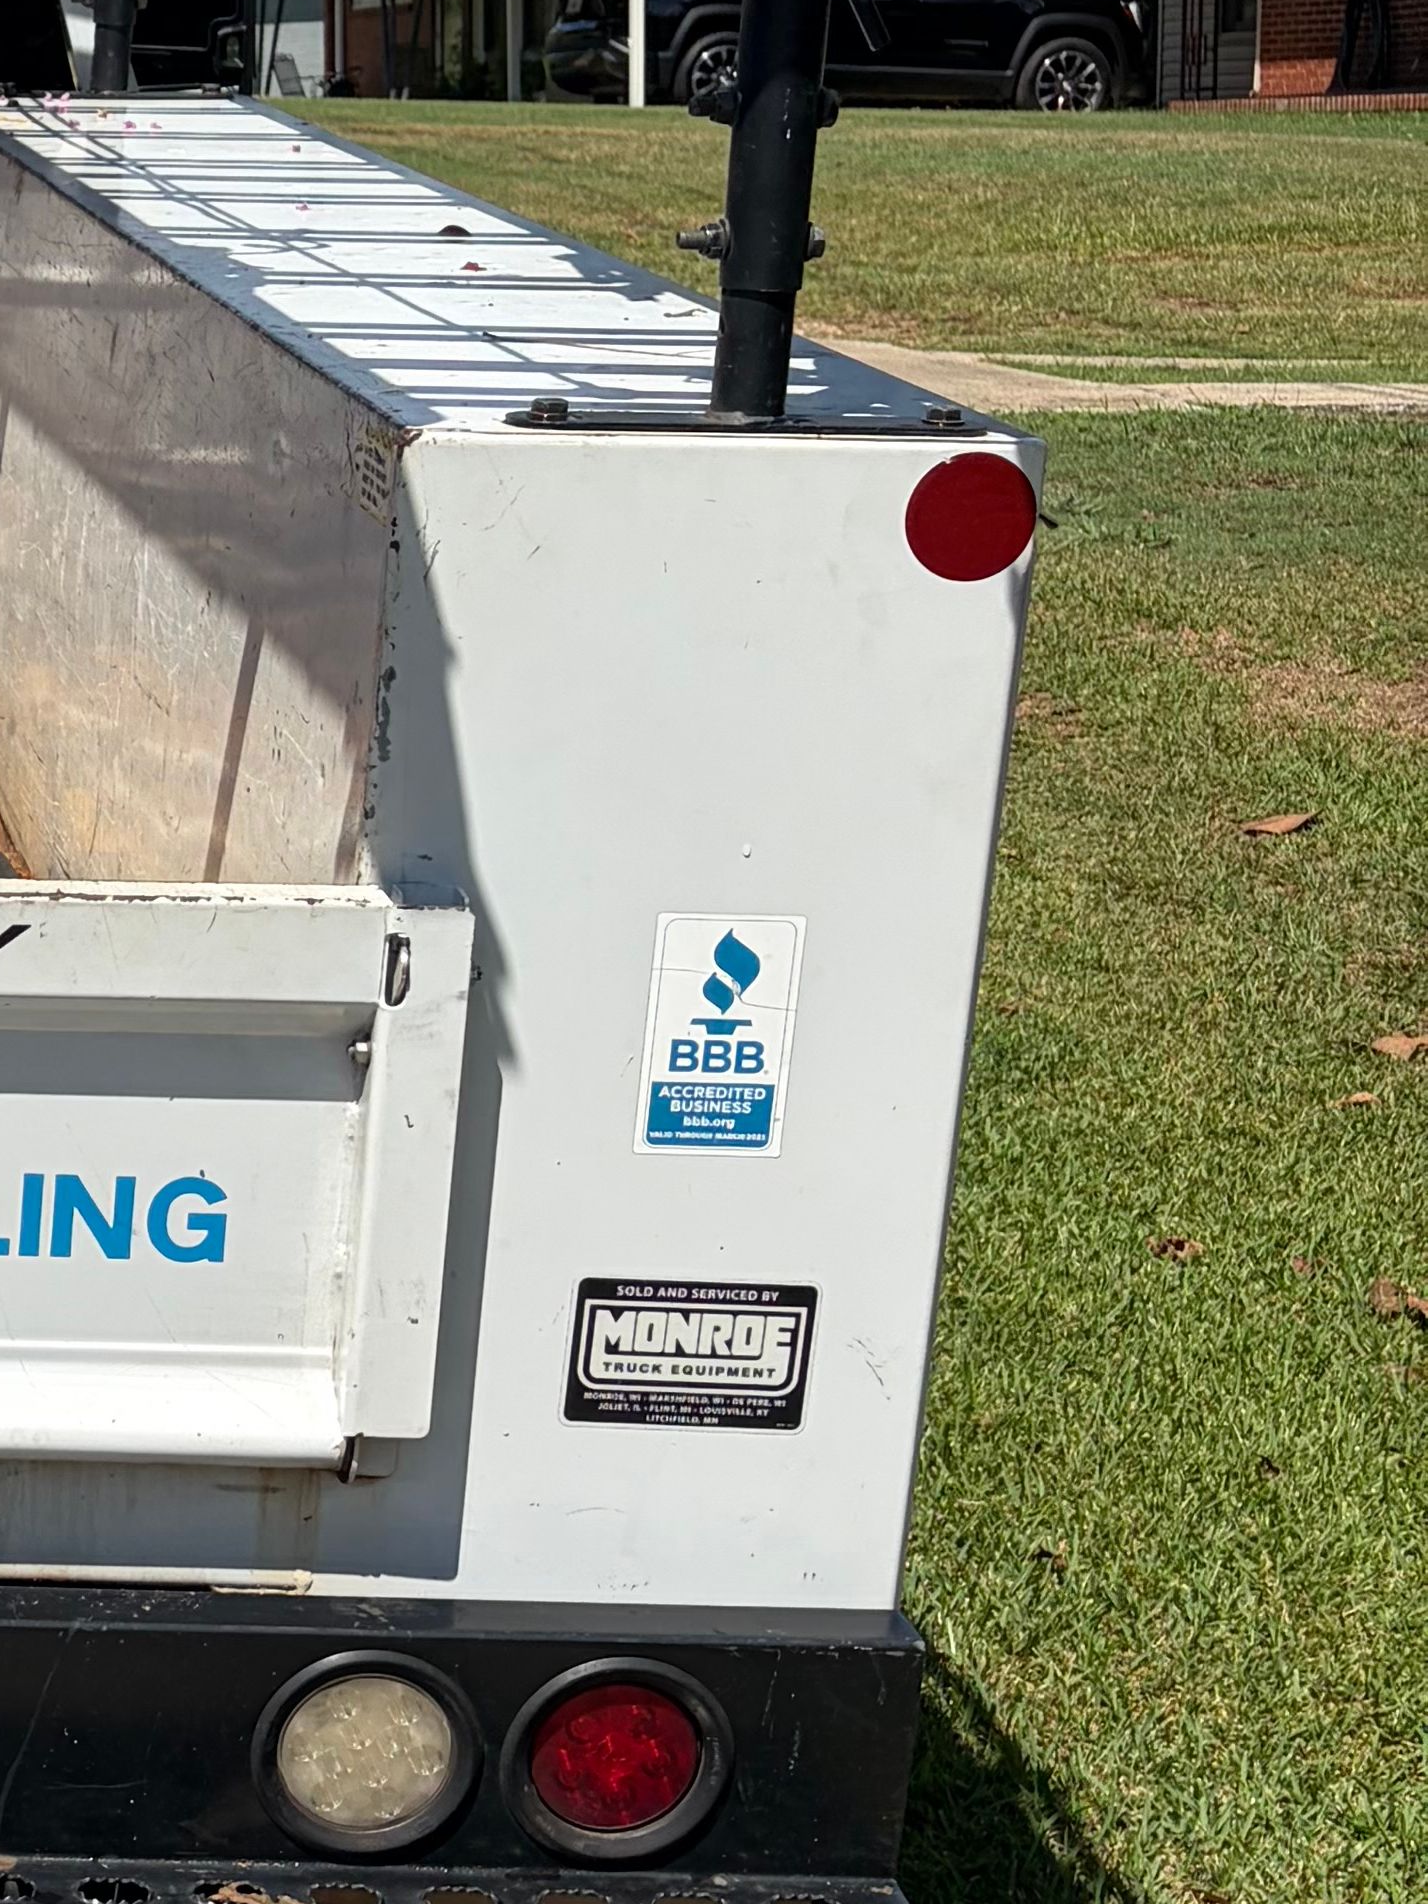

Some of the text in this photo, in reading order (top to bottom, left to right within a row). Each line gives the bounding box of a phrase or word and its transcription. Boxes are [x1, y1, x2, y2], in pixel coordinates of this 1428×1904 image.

[668, 1039, 764, 1074] BBB
[658, 1085, 766, 1100] ACCREDITED
[670, 1100, 751, 1114] BUSINESS
[683, 1117, 735, 1130] bbb.org
[616, 1285, 781, 1303] SOLD AND SERVICED BY
[593, 1309, 796, 1358] MONROE
[602, 1361, 777, 1379] TRUCK EQUIPMENT
